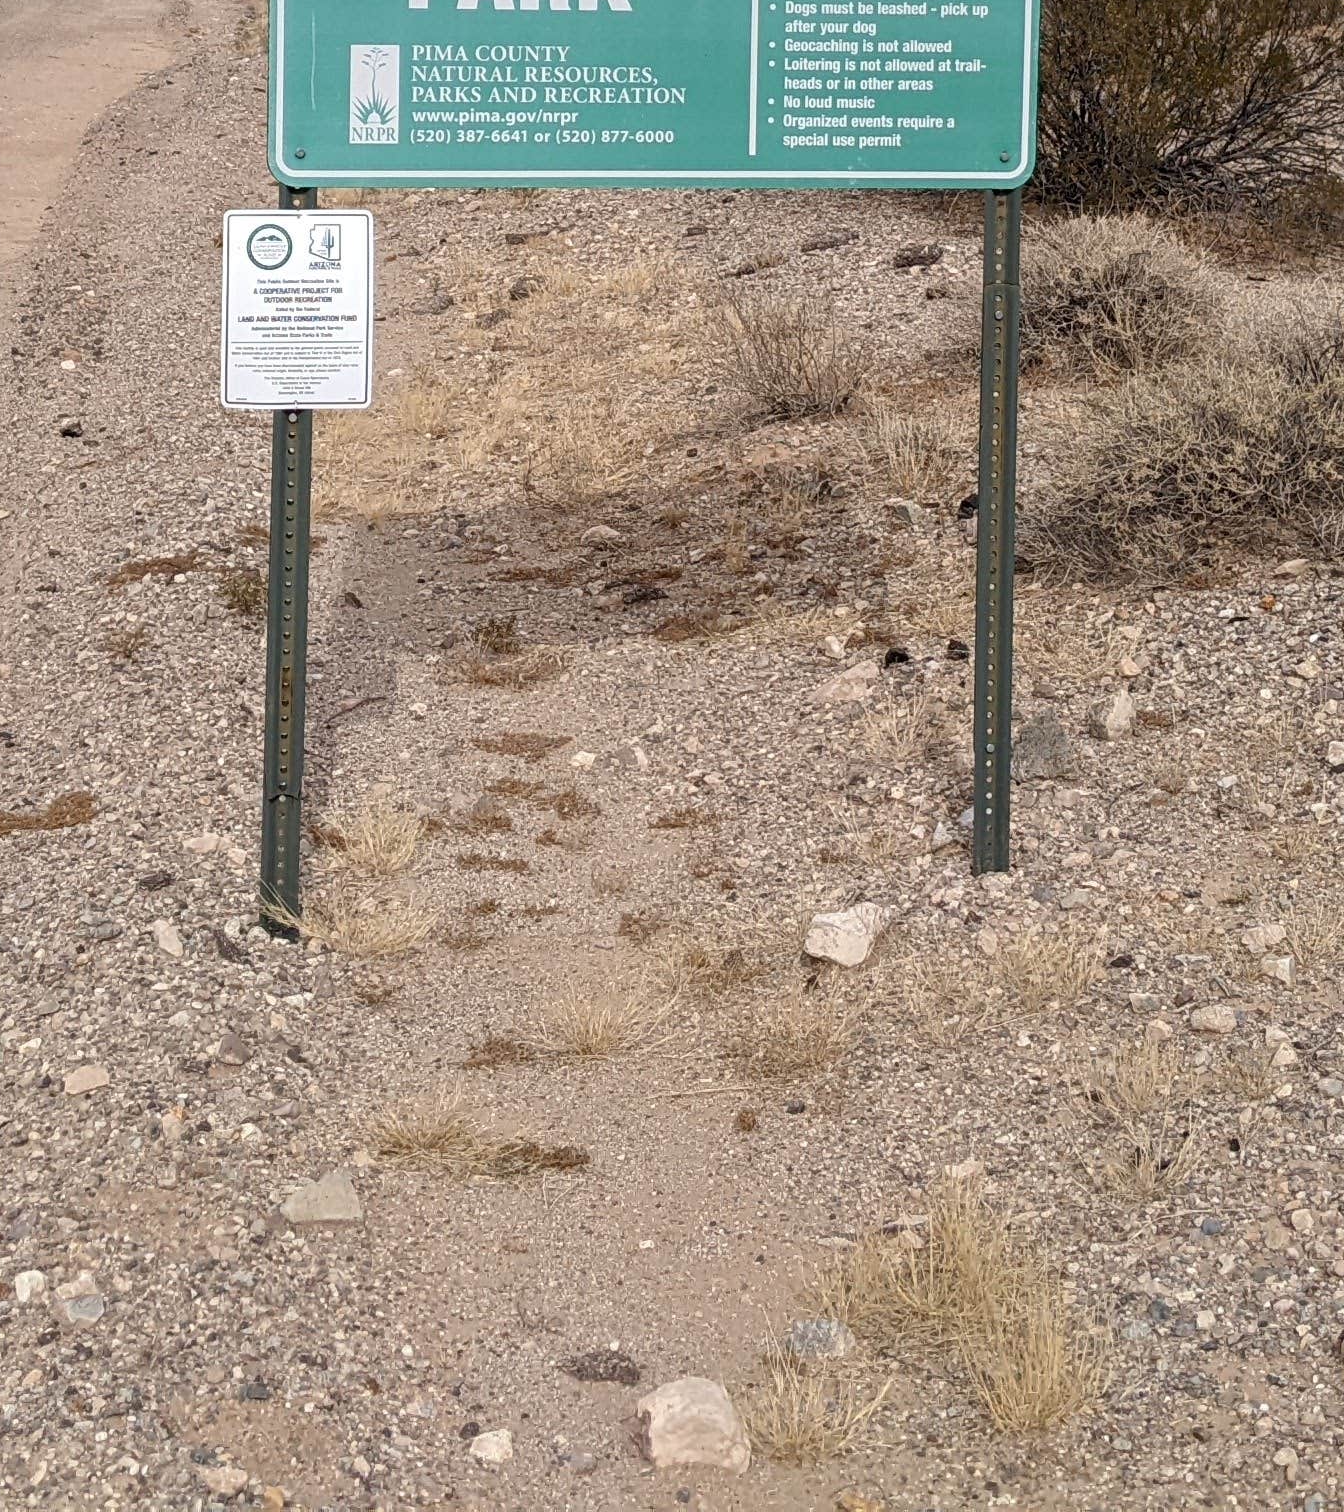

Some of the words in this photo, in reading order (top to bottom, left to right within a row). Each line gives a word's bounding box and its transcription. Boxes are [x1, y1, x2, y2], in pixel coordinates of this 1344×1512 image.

[786, 1, 817, 16] Dogs
[822, 2, 854, 14] must
[858, 2, 873, 14] be
[878, 2, 926, 15] leashed
[941, 3, 968, 17] pick
[973, 6, 988, 18] up
[785, 20, 816, 32] after
[820, 23, 849, 35] your
[853, 21, 876, 36] dog
[412, 45, 469, 61] PIMA
[476, 46, 569, 61] COUNTY
[785, 39, 858, 55] Geocaching
[863, 39, 873, 52] is
[878, 40, 898, 52] not
[903, 40, 951, 52] allowed
[785, 58, 840, 73] Loitering
[845, 58, 856, 71] is
[860, 59, 881, 71] not
[885, 59, 934, 71] allowed
[939, 59, 951, 71] at
[955, 59, 986, 71] trail-
[412, 66, 517, 82] NATURAL
[525, 67, 657, 85] RESOURCES,
[785, 77, 822, 89] heads
[827, 80, 840, 89] or
[845, 77, 855, 89] in
[860, 77, 894, 90] other
[898, 80, 933, 90] areas
[412, 87, 481, 102] PARKS
[488, 87, 536, 102] AND
[544, 87, 685, 103] RECREATION
[784, 95, 800, 108] No
[805, 96, 832, 108] loud
[837, 96, 875, 108] music
[413, 108, 578, 126] www.pima.gov/nrpr
[783, 114, 847, 129] Organized
[851, 115, 893, 127] events
[898, 115, 943, 130] require
[947, 118, 954, 128] a
[352, 127, 396, 141] NRPR
[411, 129, 450, 144] (520)
[457, 130, 526, 142] 387-6641
[534, 133, 550, 142] or
[556, 130, 595, 144] (520)
[601, 131, 674, 142] 877-6000
[783, 133, 828, 148] special
[833, 136, 855, 146] use
[859, 134, 901, 149] permit
